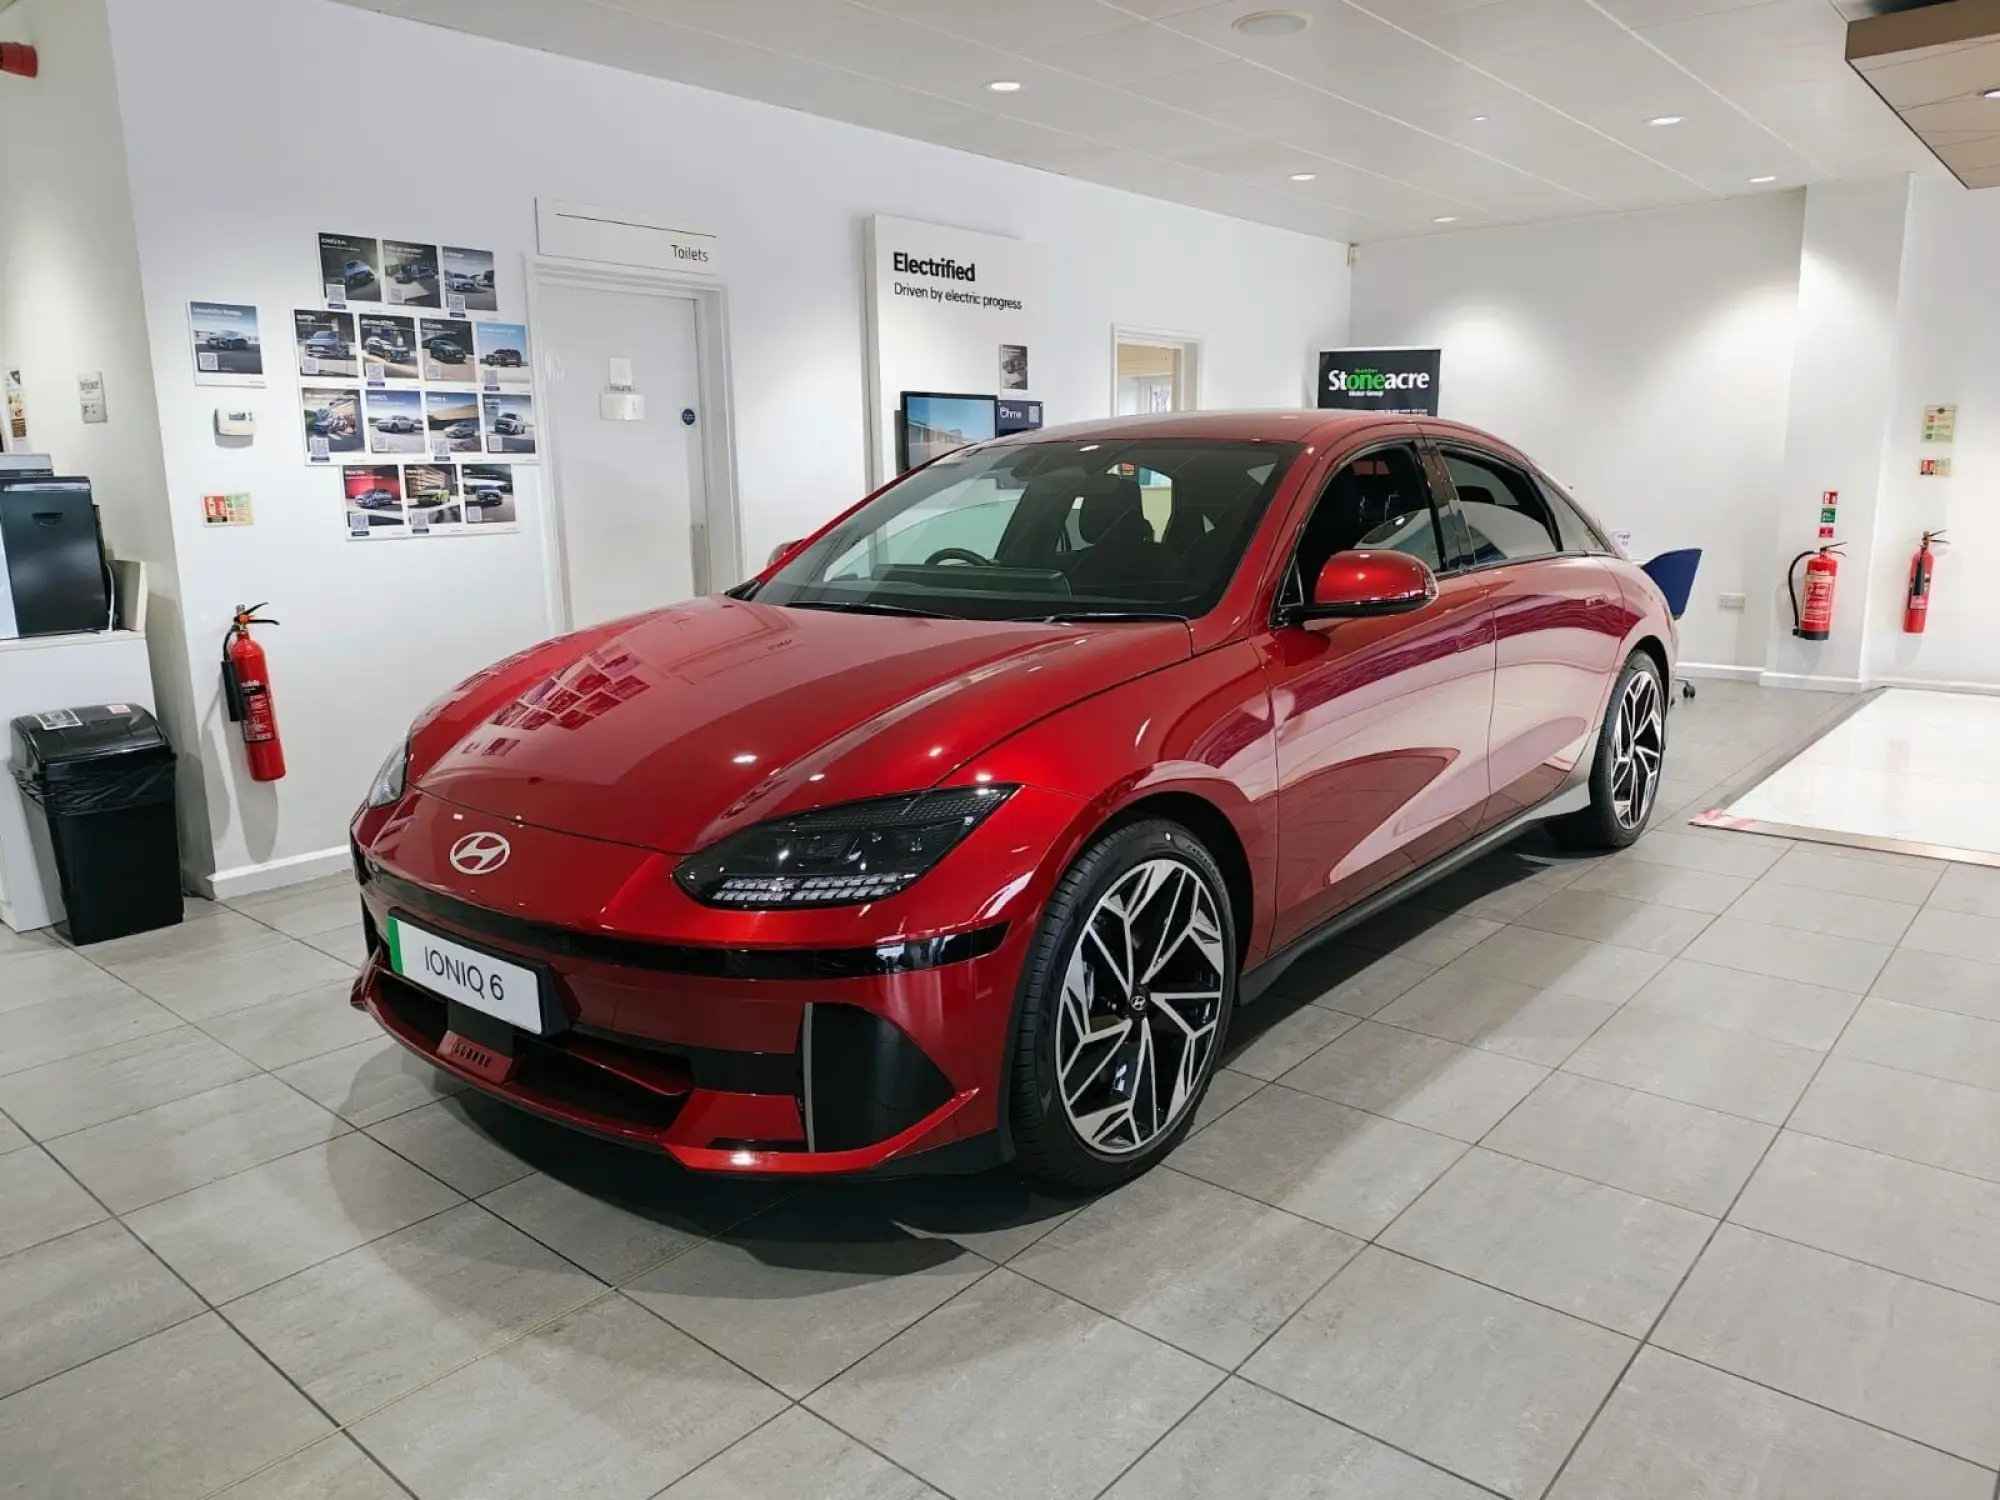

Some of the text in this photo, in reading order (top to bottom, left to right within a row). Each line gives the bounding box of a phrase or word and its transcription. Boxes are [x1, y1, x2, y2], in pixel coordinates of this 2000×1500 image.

[671, 244, 709, 262] Toilets
[893, 250, 976, 281] Electrified
[894, 281, 1022, 310] Driven by electric progress
[1328, 369, 1430, 391] Stoneacre
[424, 946, 505, 1001] IONIQ 6
